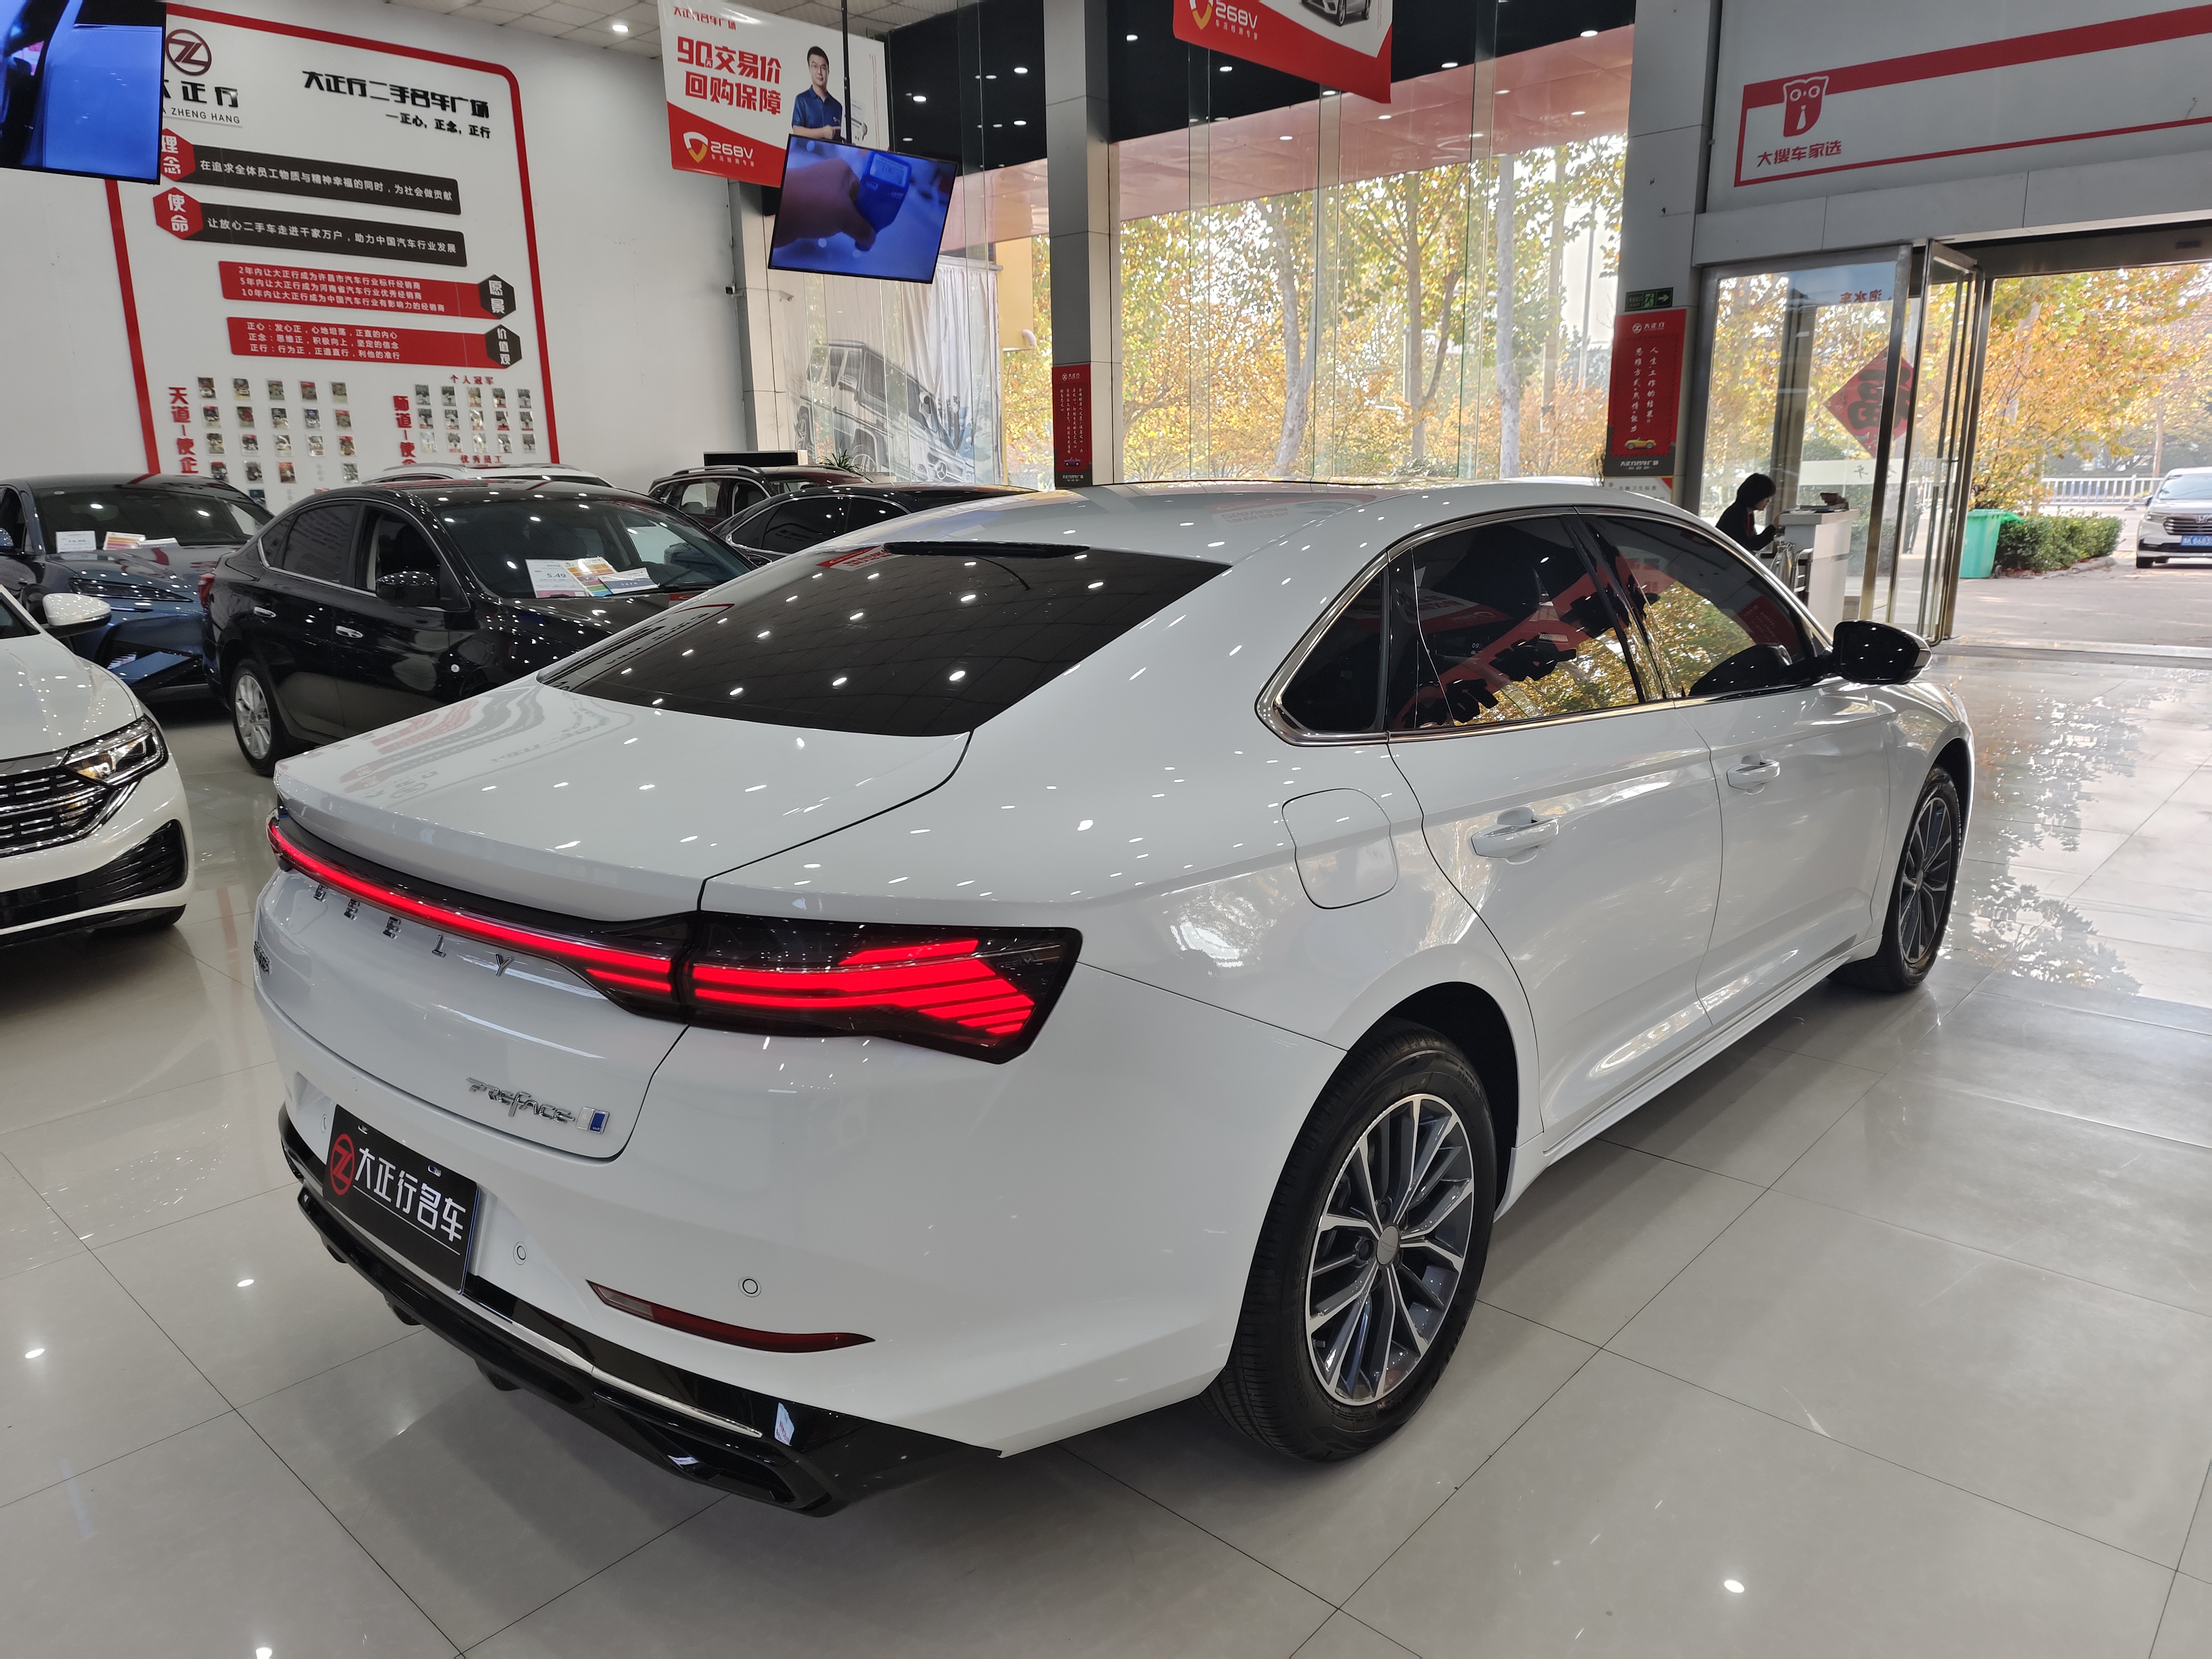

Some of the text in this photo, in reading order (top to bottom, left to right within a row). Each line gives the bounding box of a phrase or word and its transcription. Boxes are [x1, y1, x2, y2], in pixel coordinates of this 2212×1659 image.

[1216, 0, 1258, 30] 268V
[302, 71, 490, 118] 大正行二手名车广场
[685, 70, 782, 115] 回购保障
[171, 107, 206, 119] ZHENG
[211, 112, 240, 124] HANG
[161, 135, 181, 174] 理念
[710, 140, 754, 159] 268V
[1756, 139, 1842, 168] 大搜车家选
[167, 193, 188, 232] 使命
[488, 280, 505, 314] 愿景
[497, 328, 511, 365] 价值观
[461, 455, 503, 464] 优秀员工
[354, 1147, 467, 1242] 大正行名车
